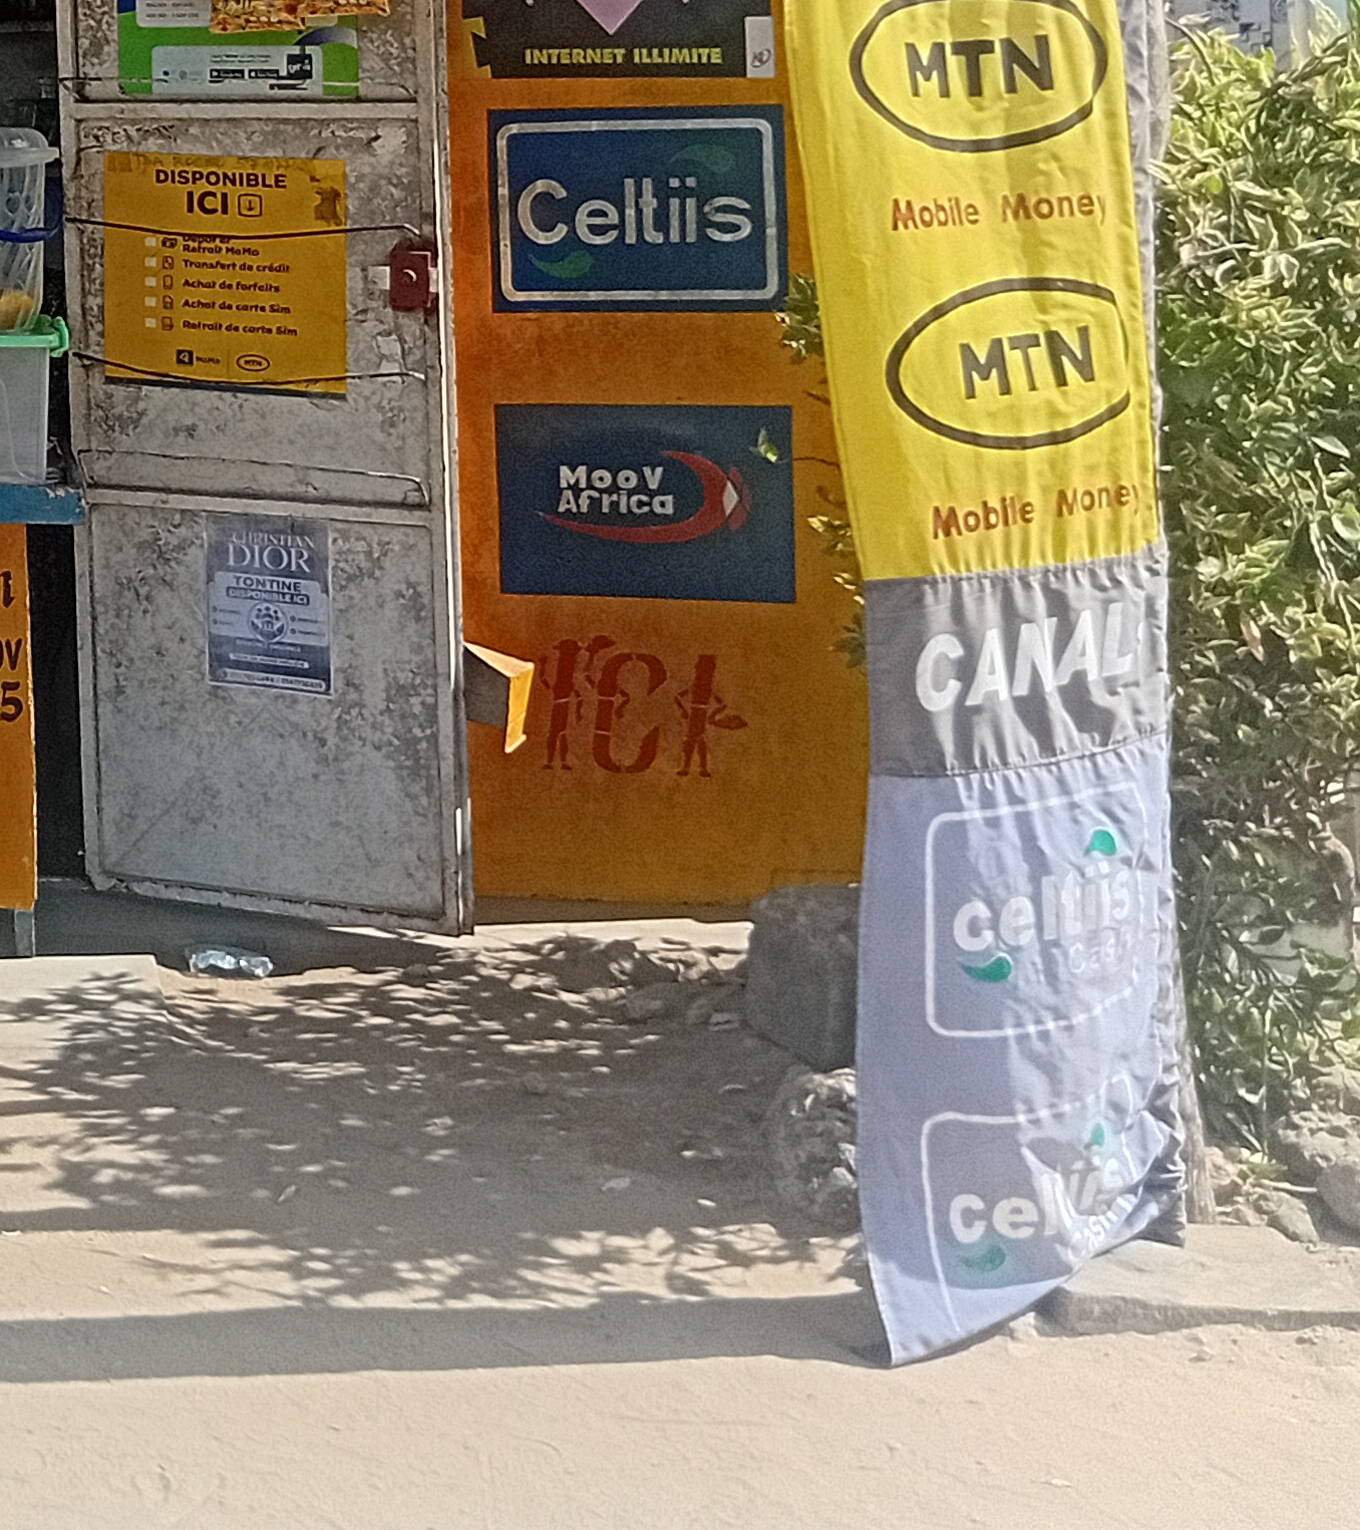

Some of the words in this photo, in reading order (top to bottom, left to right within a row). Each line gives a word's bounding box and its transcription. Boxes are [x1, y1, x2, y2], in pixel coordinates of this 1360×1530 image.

[524, 47, 625, 65] INTERNET
[632, 47, 723, 65] ILLIMITE
[904, 34, 1054, 99] MTN
[155, 169, 288, 189] DISPONIBLE
[186, 190, 229, 215] ICI
[517, 176, 753, 245] Celtiis
[891, 197, 980, 233] Mobile
[1001, 191, 1107, 227] Money
[182, 244, 223, 254] Retrait
[225, 246, 260, 257] MoMo
[182, 258, 237, 271] Transfert
[240, 261, 253, 271] de
[256, 261, 290, 273] crédit
[182, 278, 216, 290] Achat
[219, 280, 233, 290] de
[182, 298, 216, 310] Achat
[219, 300, 233, 311] de
[236, 303, 266, 313] carte
[268, 303, 291, 315] Sim
[182, 320, 223, 331] Retrait
[225, 322, 240, 333] de
[243, 324, 273, 335] carte
[275, 325, 298, 336] Sim
[959, 325, 1096, 400] MTN
[558, 489, 675, 516] Africa
[931, 495, 1035, 540] Mobile
[232, 530, 315, 549] CHRISTIAN
[228, 543, 311, 573] DIOR
[234, 574, 302, 594] TONTINE
[915, 602, 1144, 712] CANAL
